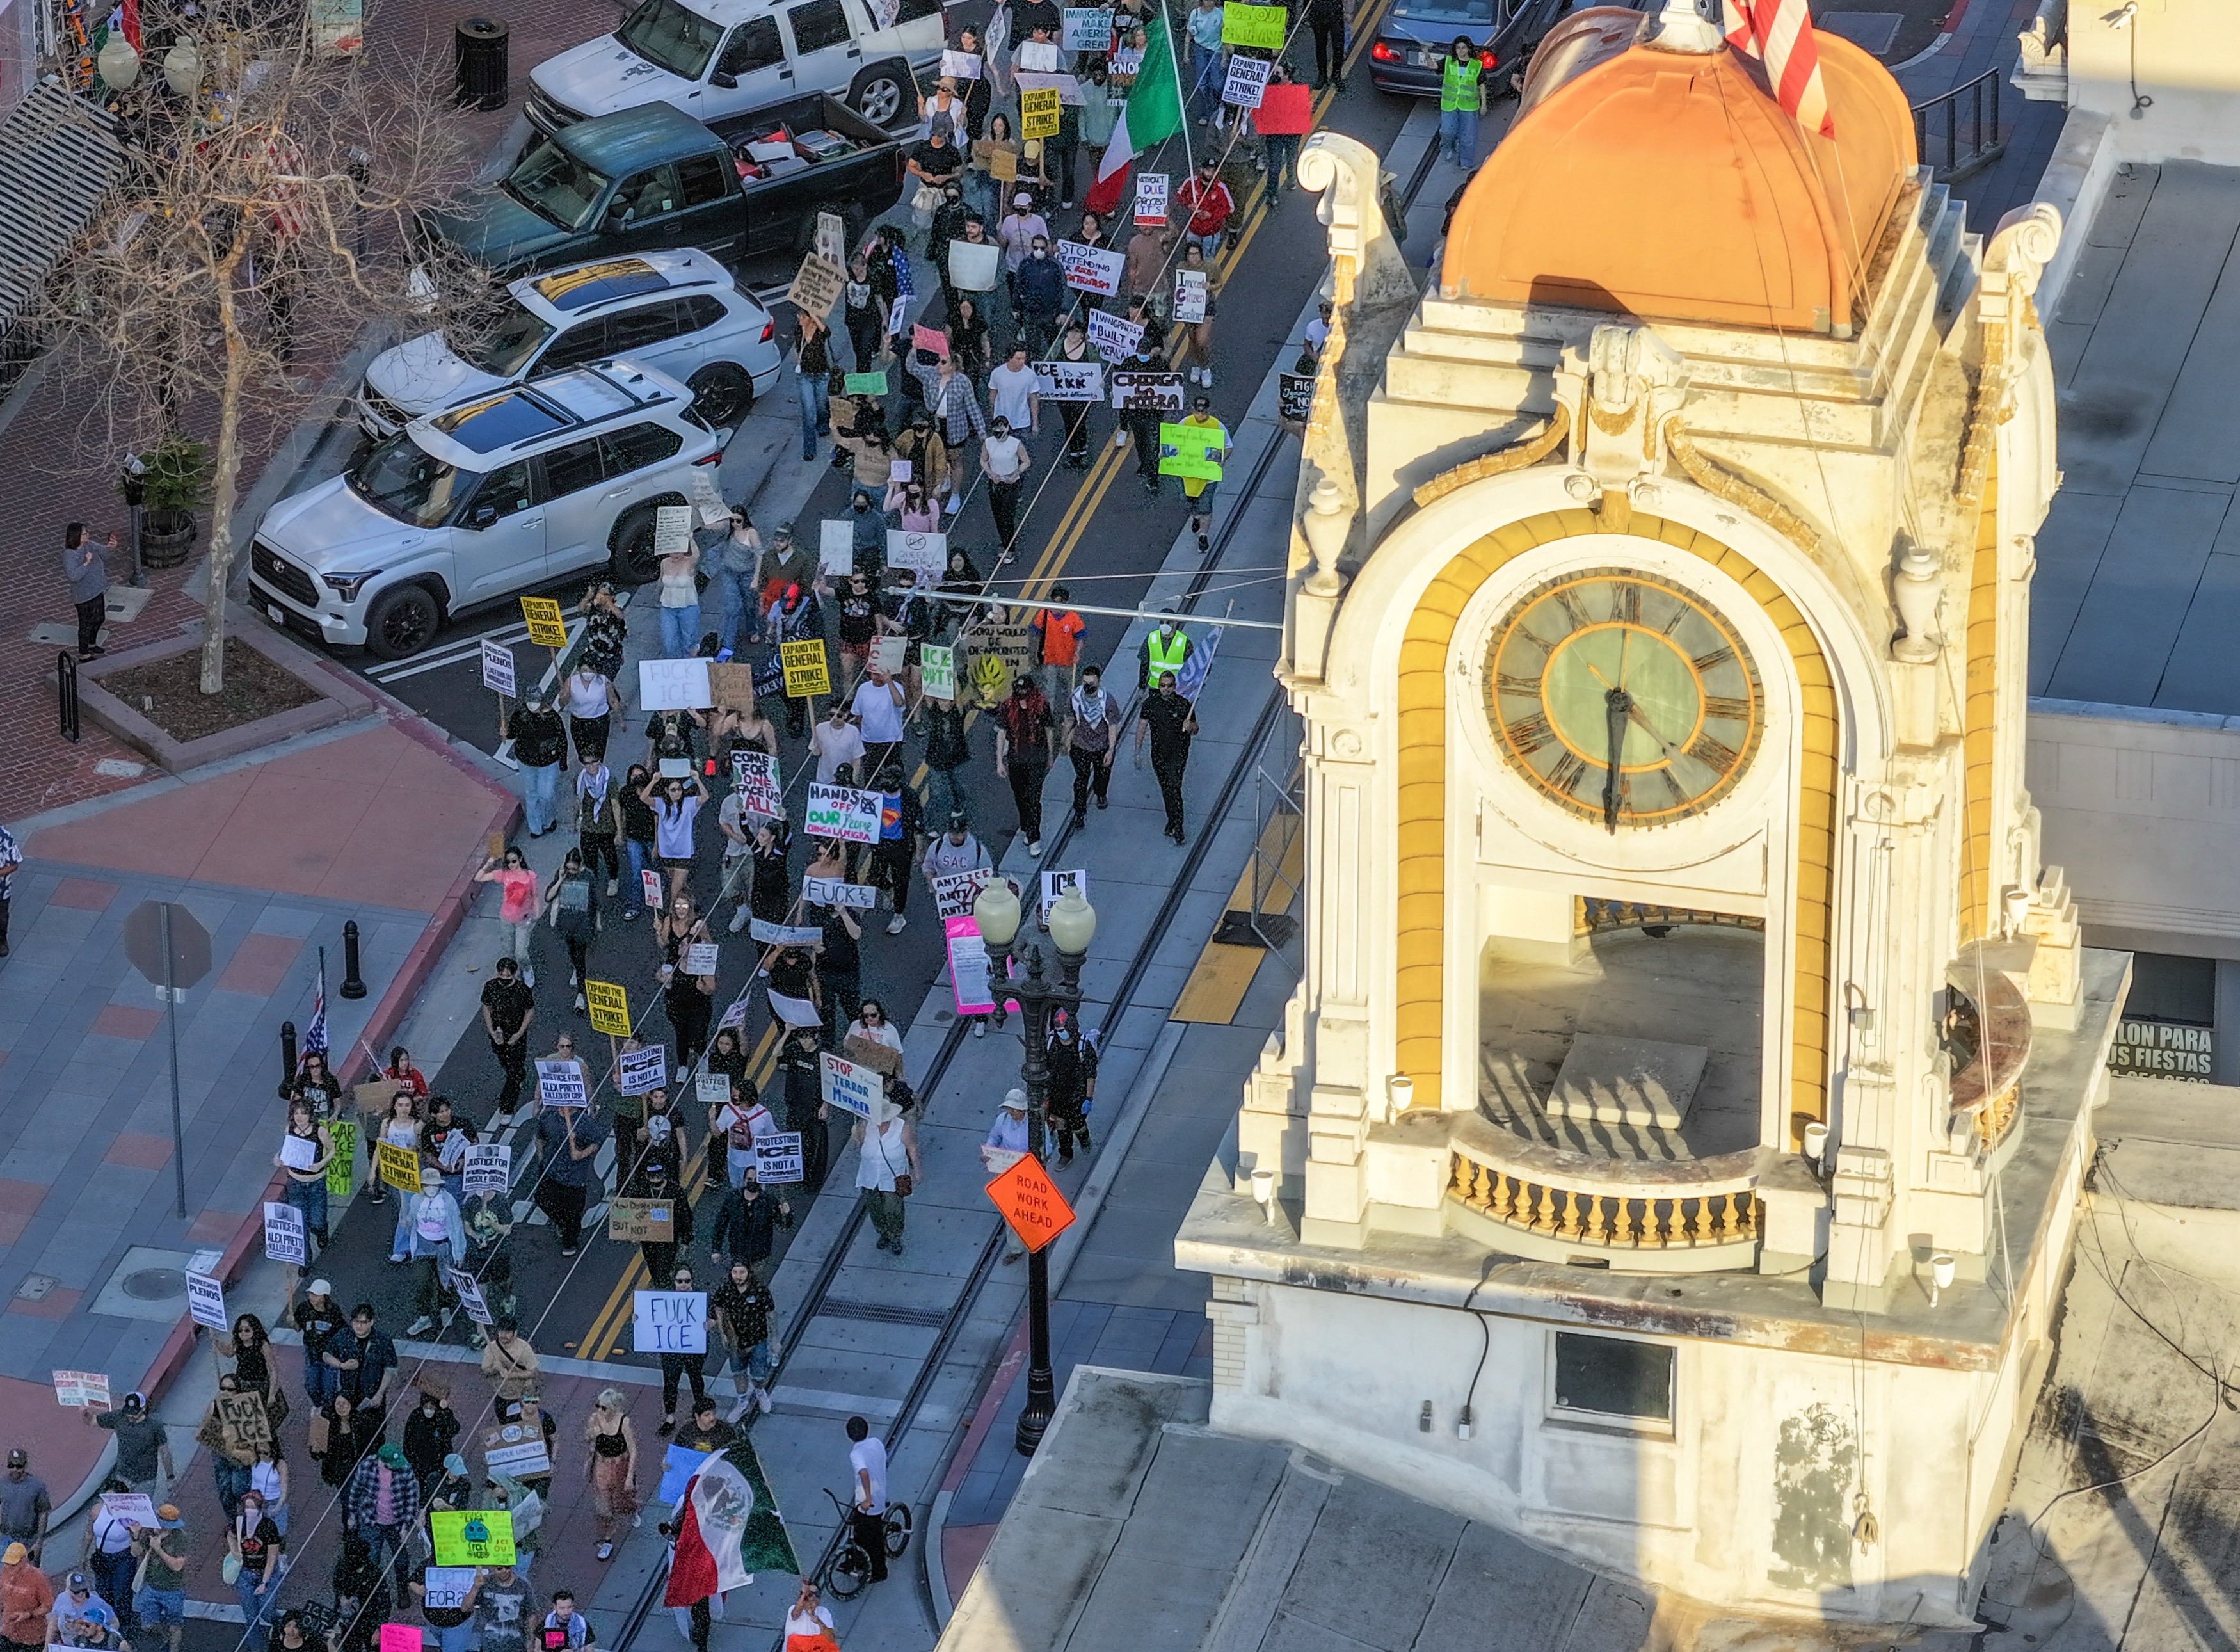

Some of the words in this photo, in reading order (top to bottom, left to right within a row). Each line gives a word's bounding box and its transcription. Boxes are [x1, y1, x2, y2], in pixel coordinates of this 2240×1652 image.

[1108, 61, 1140, 74] KNO
[1233, 58, 1255, 70] EXPAND
[1256, 63, 1268, 72] THE
[1230, 67, 1264, 83] GENERAL
[1229, 80, 1260, 95] STRIKE!
[1024, 91, 1046, 102] EXPAND
[1024, 99, 1057, 113] GENERAL
[1027, 113, 1055, 127] STRIKE!
[1144, 185, 1164, 195] DUE
[1059, 243, 1098, 257] STOP
[1097, 326, 1126, 344] BUILT
[1054, 378, 1086, 390] KKK
[1113, 374, 1184, 387] CHINGA
[1123, 394, 1180, 410] MIGRA
[523, 600, 545, 610] EXPAND
[545, 602, 557, 611] THE
[525, 609, 559, 622] GENERAL
[531, 622, 561, 636] STRIKE!
[998, 628, 1027, 637] WOULD
[783, 644, 808, 655] EXPAND
[809, 642, 821, 651] THE
[484, 652, 512, 669] PLENOS
[785, 652, 824, 668] GENERAL
[924, 648, 951, 667] ICE
[1005, 659, 1020, 667] IN
[650, 661, 694, 680] FUCK
[790, 668, 823, 684] STRIKE!
[922, 666, 952, 686] OUT!
[660, 682, 694, 703] ICE
[732, 753, 769, 766] COME
[740, 764, 768, 776] FOR
[742, 774, 771, 788] ONE
[736, 784, 764, 796] FACE
[765, 790, 781, 805] US
[810, 785, 860, 805] HANDS
[744, 795, 776, 815] ALL
[831, 801, 852, 812] OFF
[808, 810, 841, 824] OUR
[842, 829, 871, 840] MIGRA
[943, 856, 967, 869] SAC
[936, 875, 963, 888] ANTI
[966, 869, 989, 881] ICE
[808, 880, 855, 903] FUCK
[858, 887, 872, 907] ICE
[941, 905, 968, 917] ANTI
[587, 983, 611, 994] EXPAND
[611, 988, 623, 997] THE
[589, 993, 624, 1009] GENERAL
[593, 1007, 623, 1023] STRIKE!
[2159, 1026, 2212, 1053] PARA
[622, 1047, 662, 1064] PROTESTING
[2136, 1048, 2212, 1074] FIESTAS
[622, 1055, 662, 1074] ICE
[827, 1057, 853, 1077] STOP
[541, 1072, 567, 1081] JUSTICE
[628, 1075, 636, 1084] IS
[637, 1071, 652, 1081] NOT
[543, 1082, 558, 1091] ALEX
[559, 1083, 583, 1093] PRETTI
[832, 1074, 869, 1098] TERROR
[756, 1135, 799, 1146] PROTESTING
[756, 1145, 799, 1159] ICE
[383, 1153, 416, 1171] GENERAL
[467, 1157, 494, 1167] JUSTICE
[495, 1157, 508, 1169] FOR
[764, 1162, 771, 1171] IS
[772, 1160, 788, 1170] NOT
[790, 1160, 796, 1168] A
[384, 1163, 415, 1180] STRIKE!
[758, 1169, 801, 1177] CRIME!
[1017, 1175, 1048, 1194] ROAD
[1016, 1191, 1048, 1210] WORK
[1013, 1207, 1053, 1228] AHEAD
[266, 1219, 291, 1232] JUSTICE
[292, 1223, 302, 1235] FOR
[612, 1221, 628, 1231] BUT
[630, 1226, 648, 1236] NOT
[268, 1232, 282, 1244] ALEX
[283, 1234, 303, 1247] PRETTI
[189, 1285, 221, 1302] PLENOS
[651, 1298, 697, 1324] FUCK
[654, 1324, 693, 1350] ICE
[220, 1396, 265, 1420] FUCK
[515, 1445, 543, 1456] UNITED
[428, 1591, 455, 1606] FOR
[307, 1602, 330, 1619] ICE
